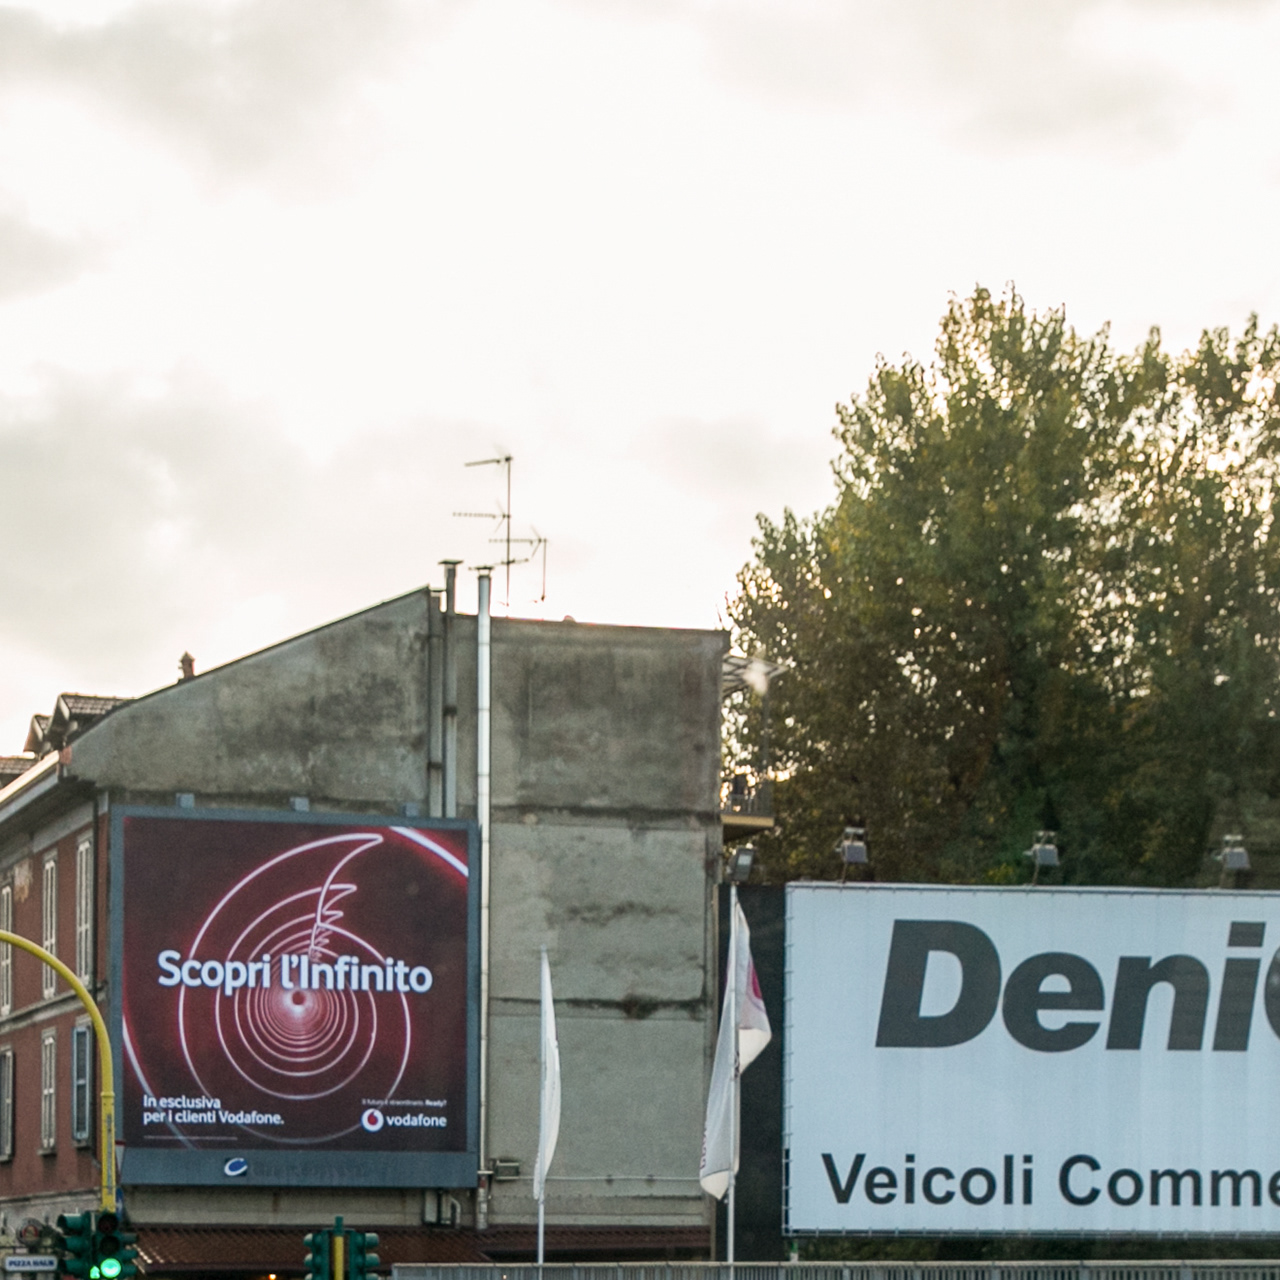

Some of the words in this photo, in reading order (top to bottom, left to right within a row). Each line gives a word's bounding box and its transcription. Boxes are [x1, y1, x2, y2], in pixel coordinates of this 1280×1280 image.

[158, 950, 271, 995] Scopri
[281, 955, 433, 993] l'Infinito
[143, 1095, 157, 1108] In
[159, 1095, 221, 1109] esclusiva
[143, 1112, 166, 1125] per
[168, 1111, 172, 1122] i
[175, 1110, 216, 1123] clienti
[219, 1111, 285, 1124] Vodafone.
[386, 1113, 447, 1127] vodafone
[821, 1151, 1033, 1206] Veicoli
